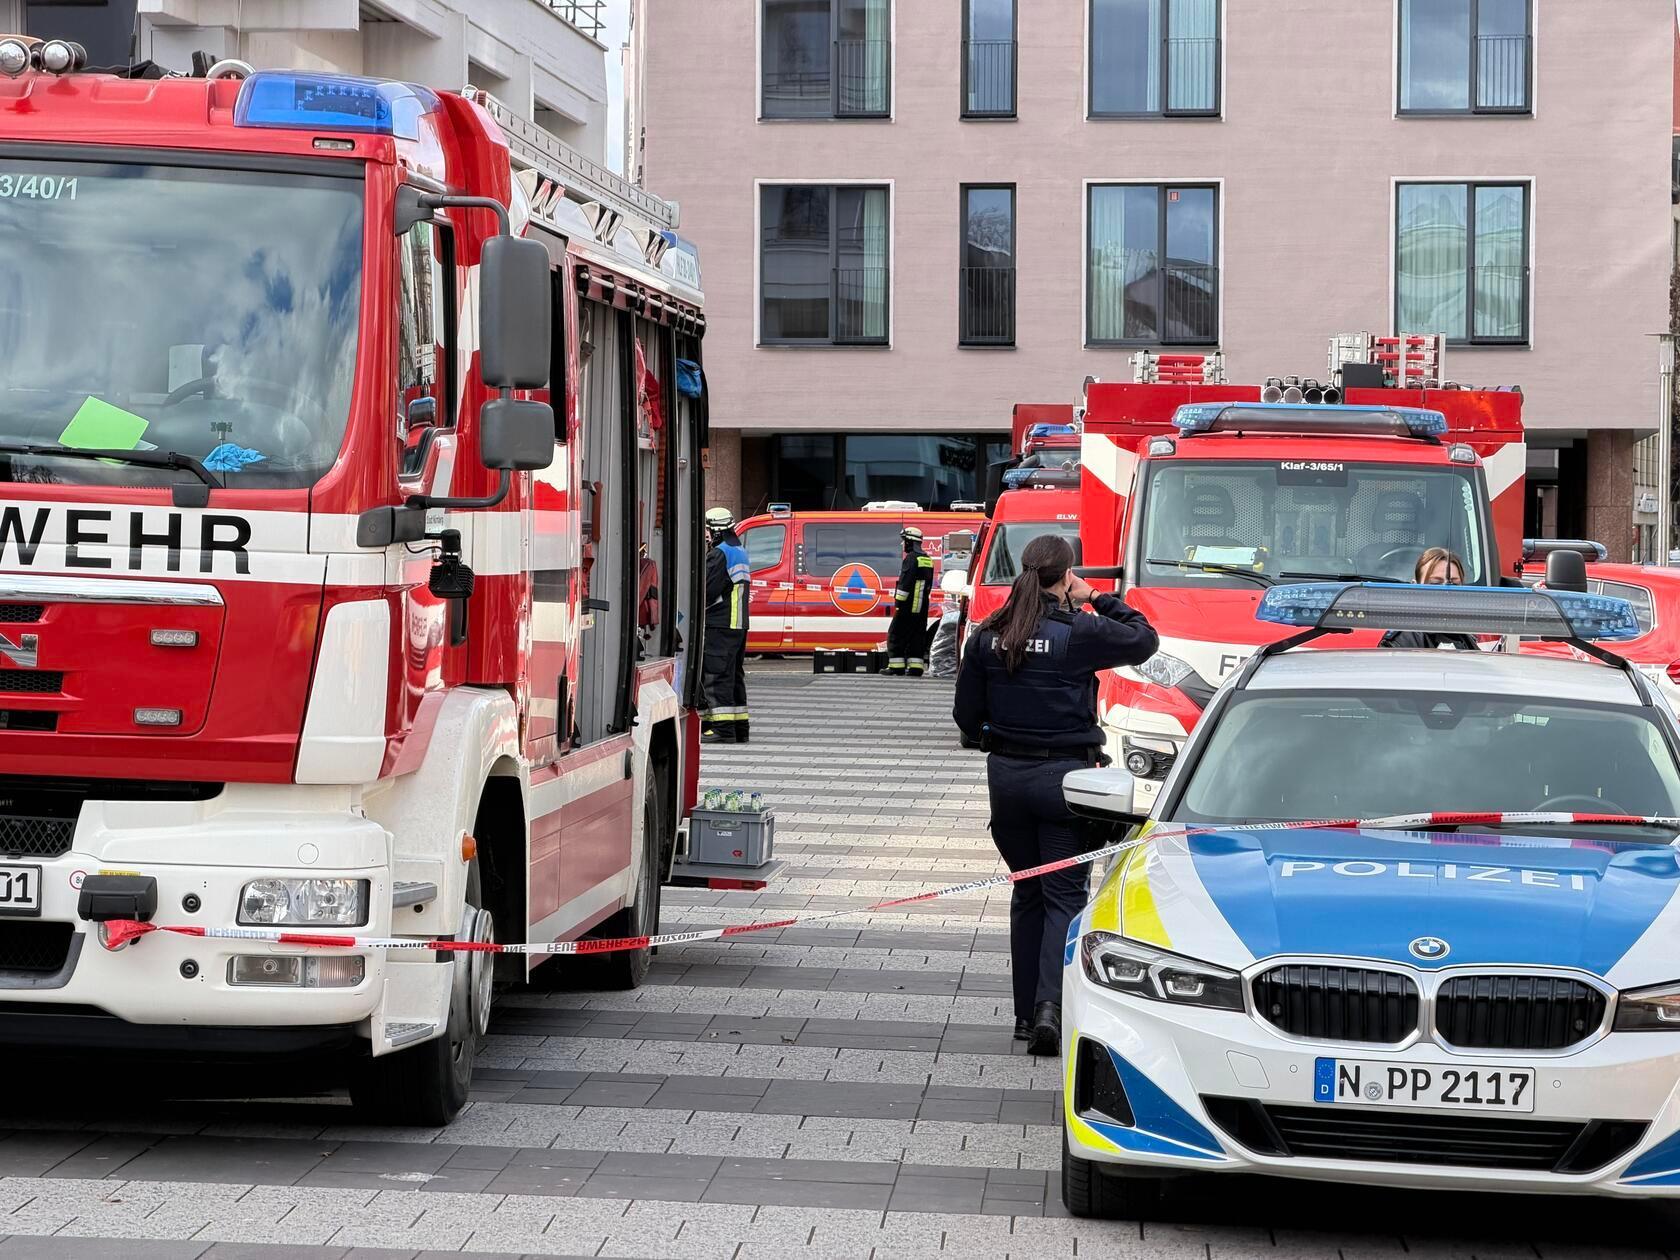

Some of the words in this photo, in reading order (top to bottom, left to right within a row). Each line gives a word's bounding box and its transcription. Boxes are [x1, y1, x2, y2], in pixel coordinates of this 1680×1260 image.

[0, 174, 78, 200] 3/40/1
[1280, 461, 1344, 472] Klaf-3/65/1
[0, 506, 252, 575] WEHR
[1280, 860, 1585, 891] POLIZEI
[1321, 1084, 1329, 1094] D
[1339, 1064, 1361, 1098] N
[1387, 1067, 1432, 1101] PP
[1440, 1070, 1530, 1106] 2117
